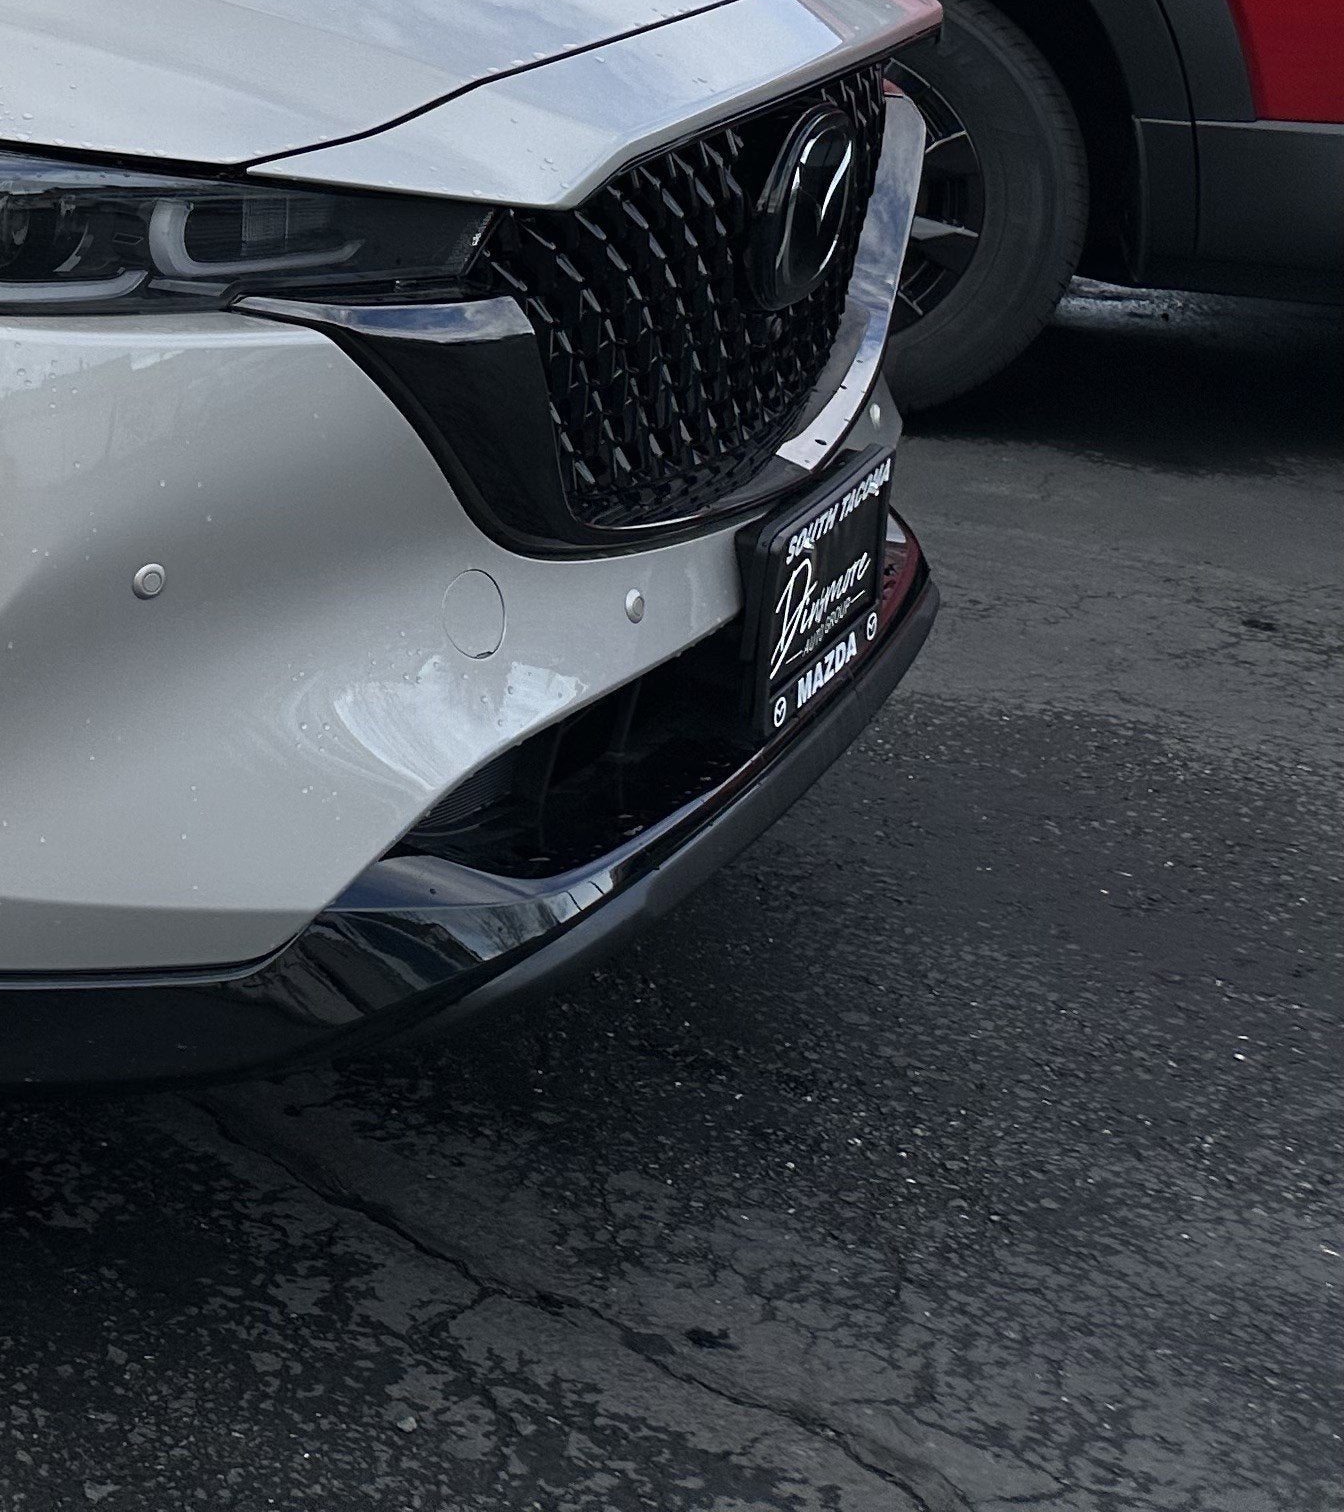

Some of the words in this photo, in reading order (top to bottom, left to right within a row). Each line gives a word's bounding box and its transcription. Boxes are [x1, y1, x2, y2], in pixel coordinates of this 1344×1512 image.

[786, 502, 839, 565] SOUTH
[839, 458, 891, 521] TACOMA
[769, 552, 871, 679] Dinsmore
[797, 631, 858, 708] MAZDA
